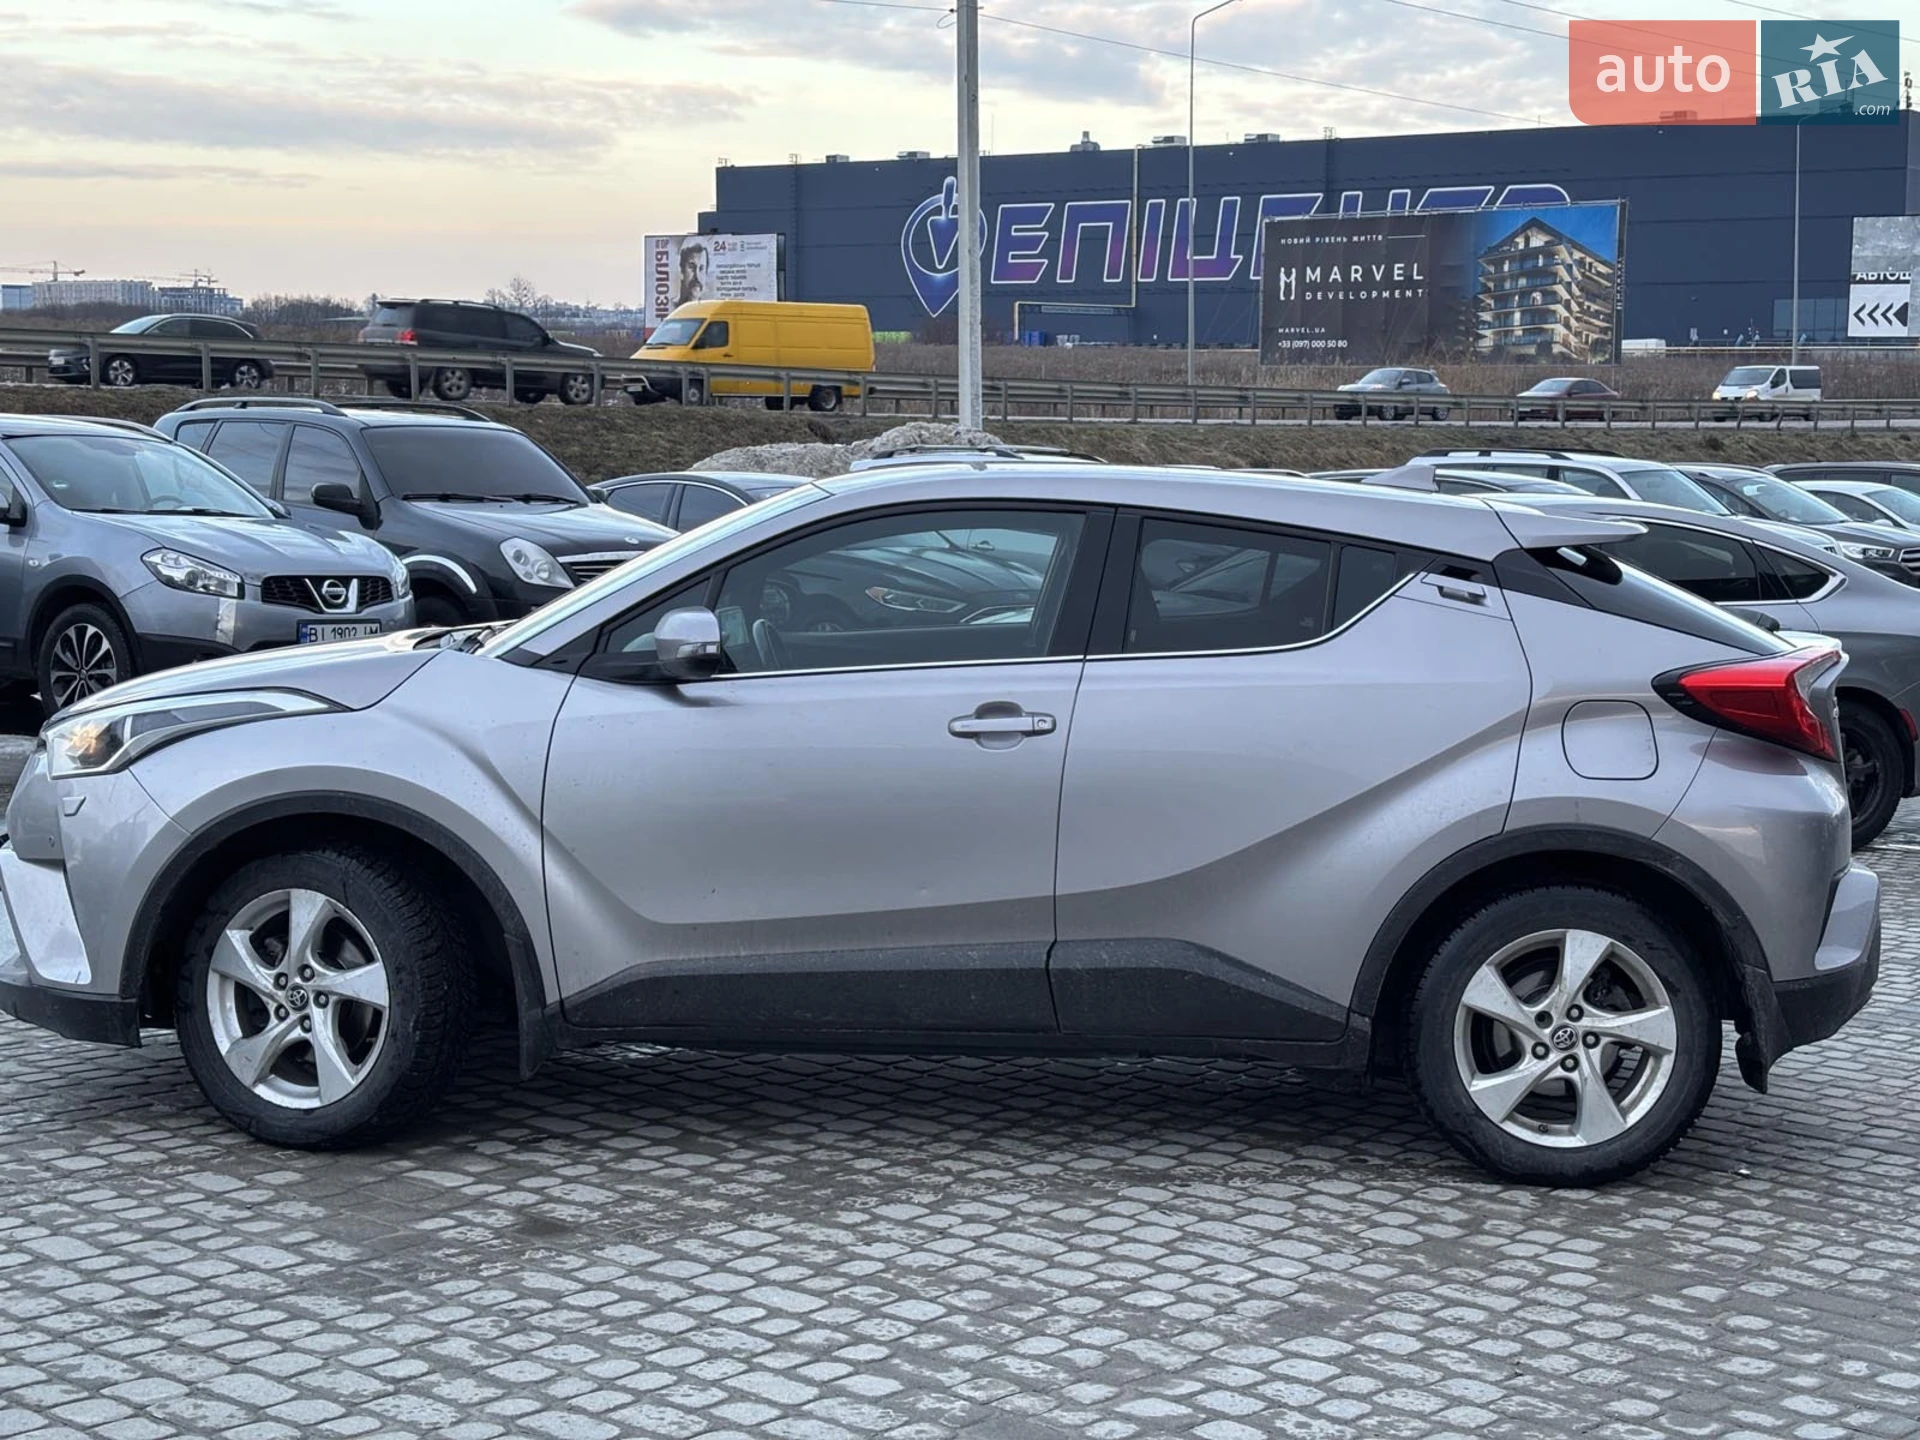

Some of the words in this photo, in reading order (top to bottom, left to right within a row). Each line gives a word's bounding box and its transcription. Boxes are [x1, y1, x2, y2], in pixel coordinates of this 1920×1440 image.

[713, 240, 727, 252] 24
[1281, 236, 1311, 245] НОВИЙ
[1315, 236, 1348, 244] РІВЕНЬ
[1305, 262, 1424, 283] MARVEL
[1305, 289, 1423, 300] DEVELOPMENT
[309, 626, 325, 643] BI
